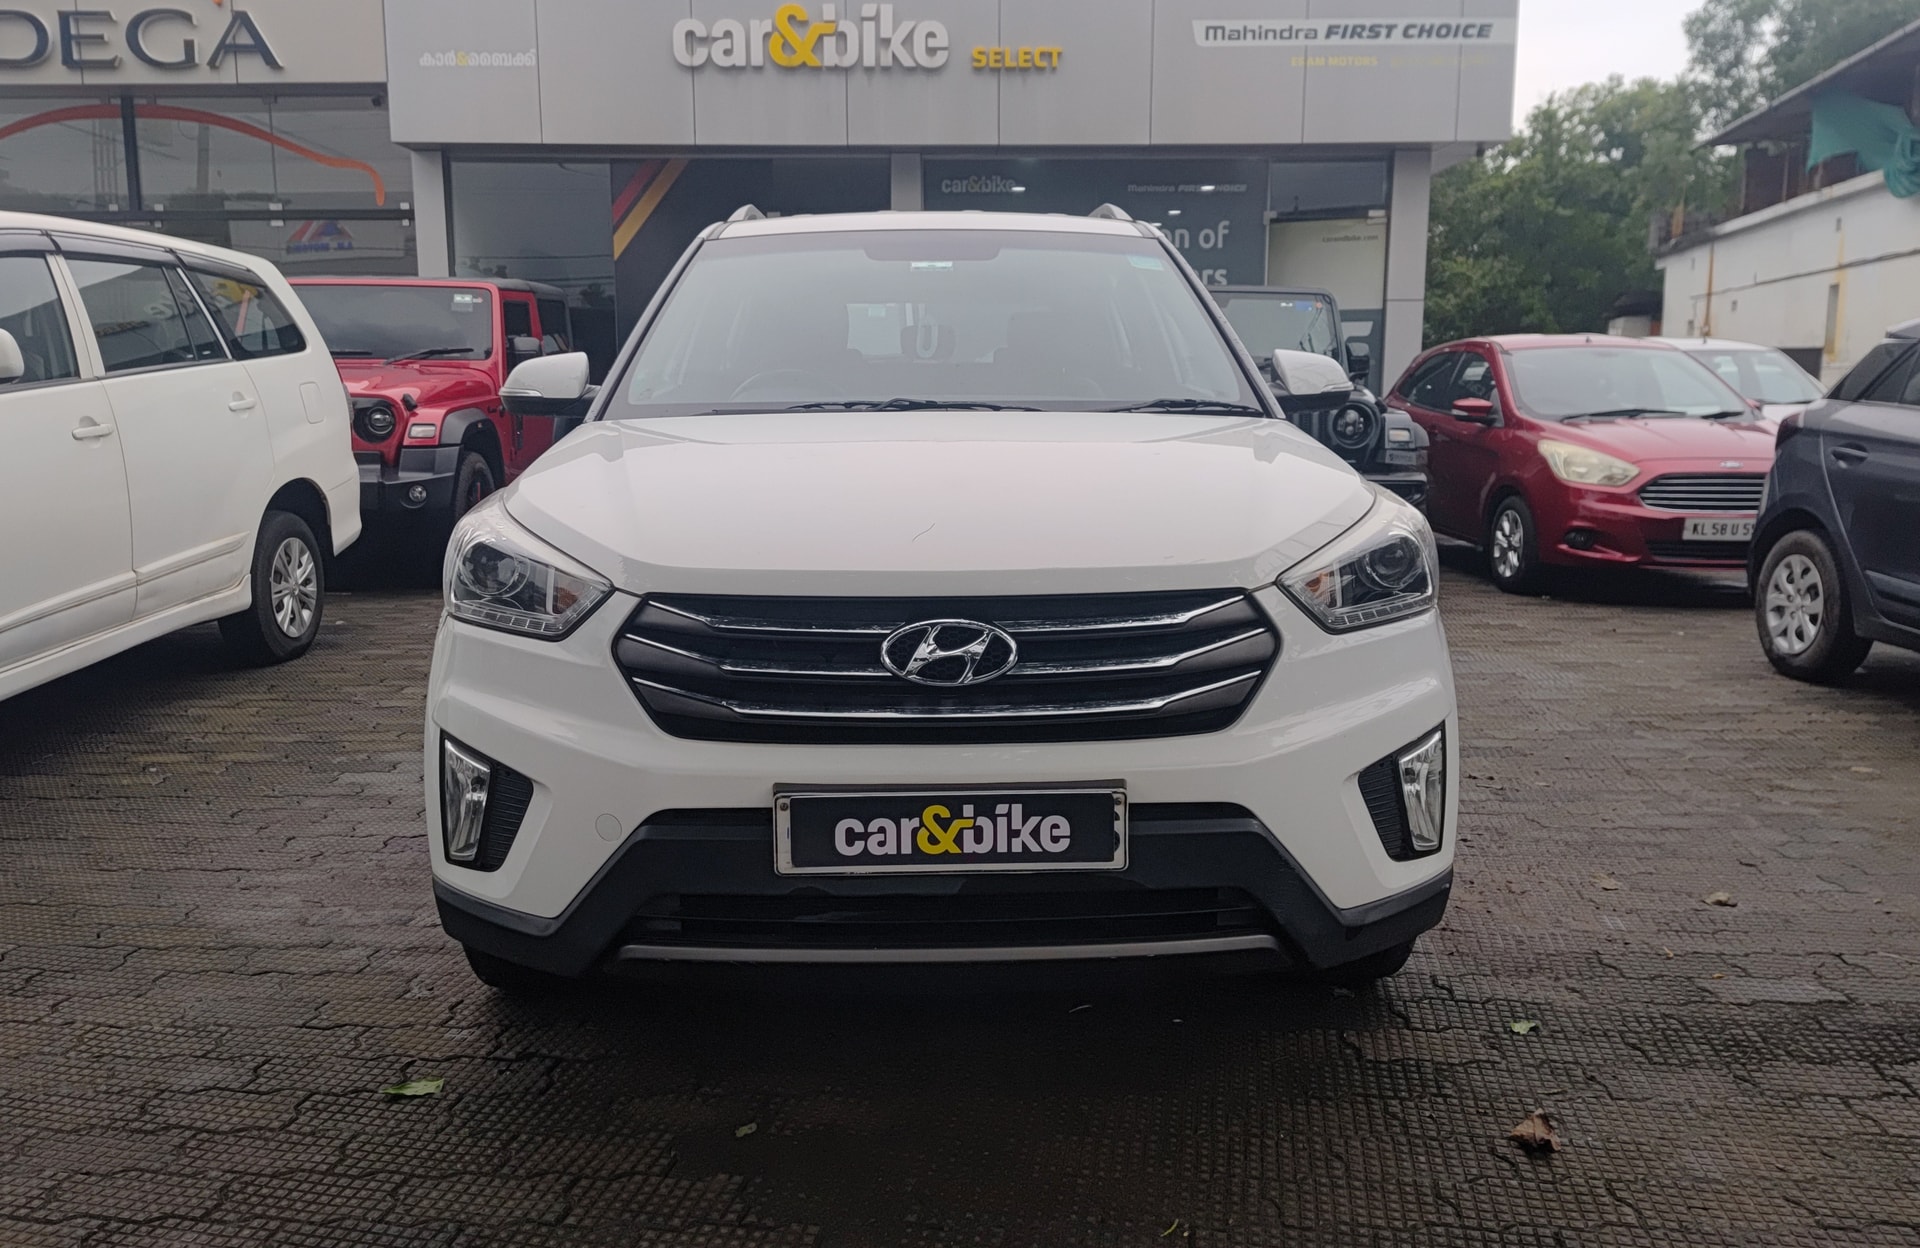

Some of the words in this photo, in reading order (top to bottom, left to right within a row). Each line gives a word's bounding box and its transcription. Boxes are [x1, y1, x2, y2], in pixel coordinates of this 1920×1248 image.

[672, 3, 949, 69] car&bike
[1204, 25, 1318, 41] Mahindra
[1324, 24, 1398, 40] FIRST
[1402, 22, 1493, 39] CHOICE
[972, 46, 1062, 70] SELECT
[1328, 55, 1378, 67] MOTORS
[941, 175, 1017, 193] car&bike
[1127, 184, 1175, 192] Mahindra
[1177, 184, 1208, 192] FIRS
[1198, 220, 1230, 249] of
[1691, 522, 1708, 536] KL
[1730, 522, 1739, 535] U
[834, 803, 1071, 857] car&bike
